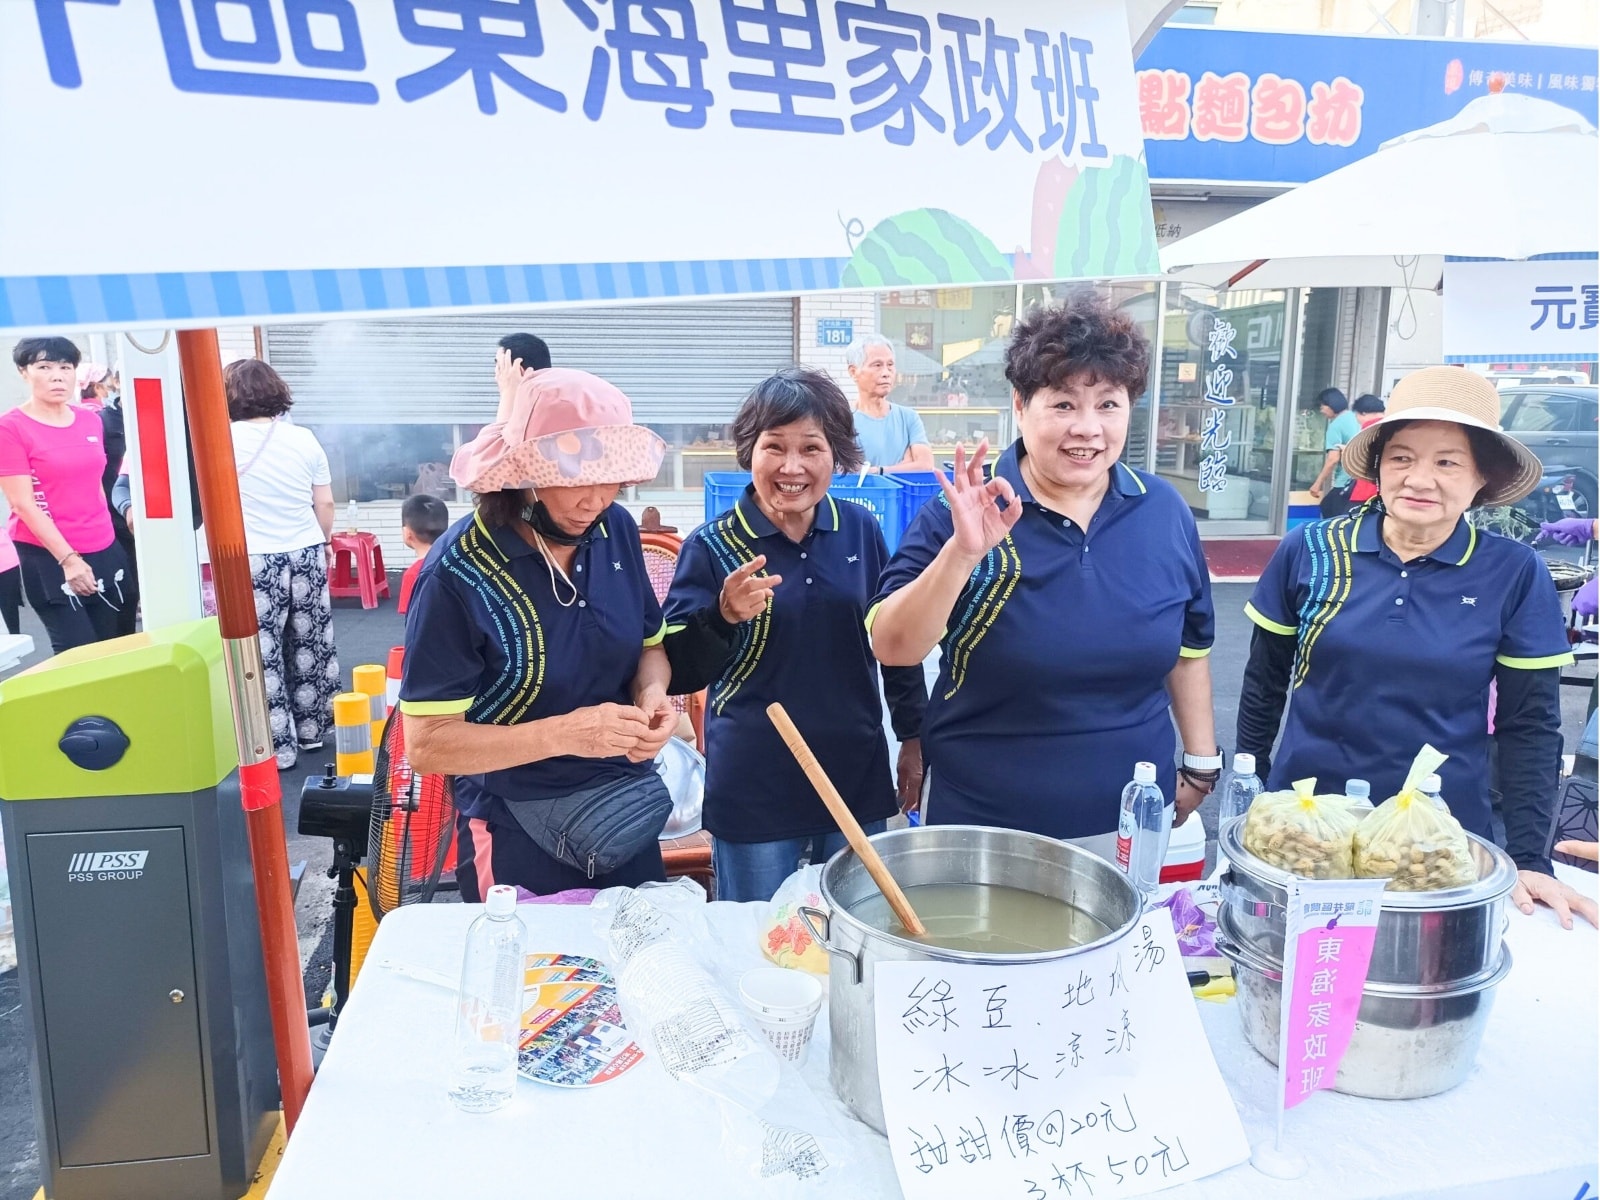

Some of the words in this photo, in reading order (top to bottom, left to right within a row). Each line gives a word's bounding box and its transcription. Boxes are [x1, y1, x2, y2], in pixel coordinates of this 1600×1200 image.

[1136, 69, 1364, 147] 點麵包坊
[1199, 318, 1238, 492] 歡迎光臨
[476, 547, 501, 571] SPEEDMAX
[482, 581, 506, 607] SPEEDMAX
[500, 569, 523, 595] SPEEDMAX
[972, 576, 992, 603] SPEEDMAX
[986, 573, 1006, 602] SPEEDMAX
[1002, 571, 1021, 600] SPEEDMAX
[448, 565, 476, 588] SPEEDMAX
[476, 585, 493, 613] SPEEDMAX
[491, 612, 507, 642] SPEEDMAX
[512, 600, 530, 629] SPEEDMAX
[521, 593, 539, 622] SPEEDMAX
[984, 600, 1006, 628] SPEEDMAX
[503, 606, 520, 636] SPEEDMAX
[514, 636, 523, 667] SPEEDMAX
[525, 630, 534, 660] SPEEDMAX
[535, 623, 546, 652] SPEEDMAX
[968, 626, 987, 651] SPEEDMAX
[522, 661, 534, 689] SPEEDMAX
[537, 654, 546, 685] SPEEDMAX
[476, 700, 500, 722] SPEEDMAX
[99, 853, 140, 868] PSS
[68, 872, 94, 882] PSS
[97, 870, 143, 881] GROUP
